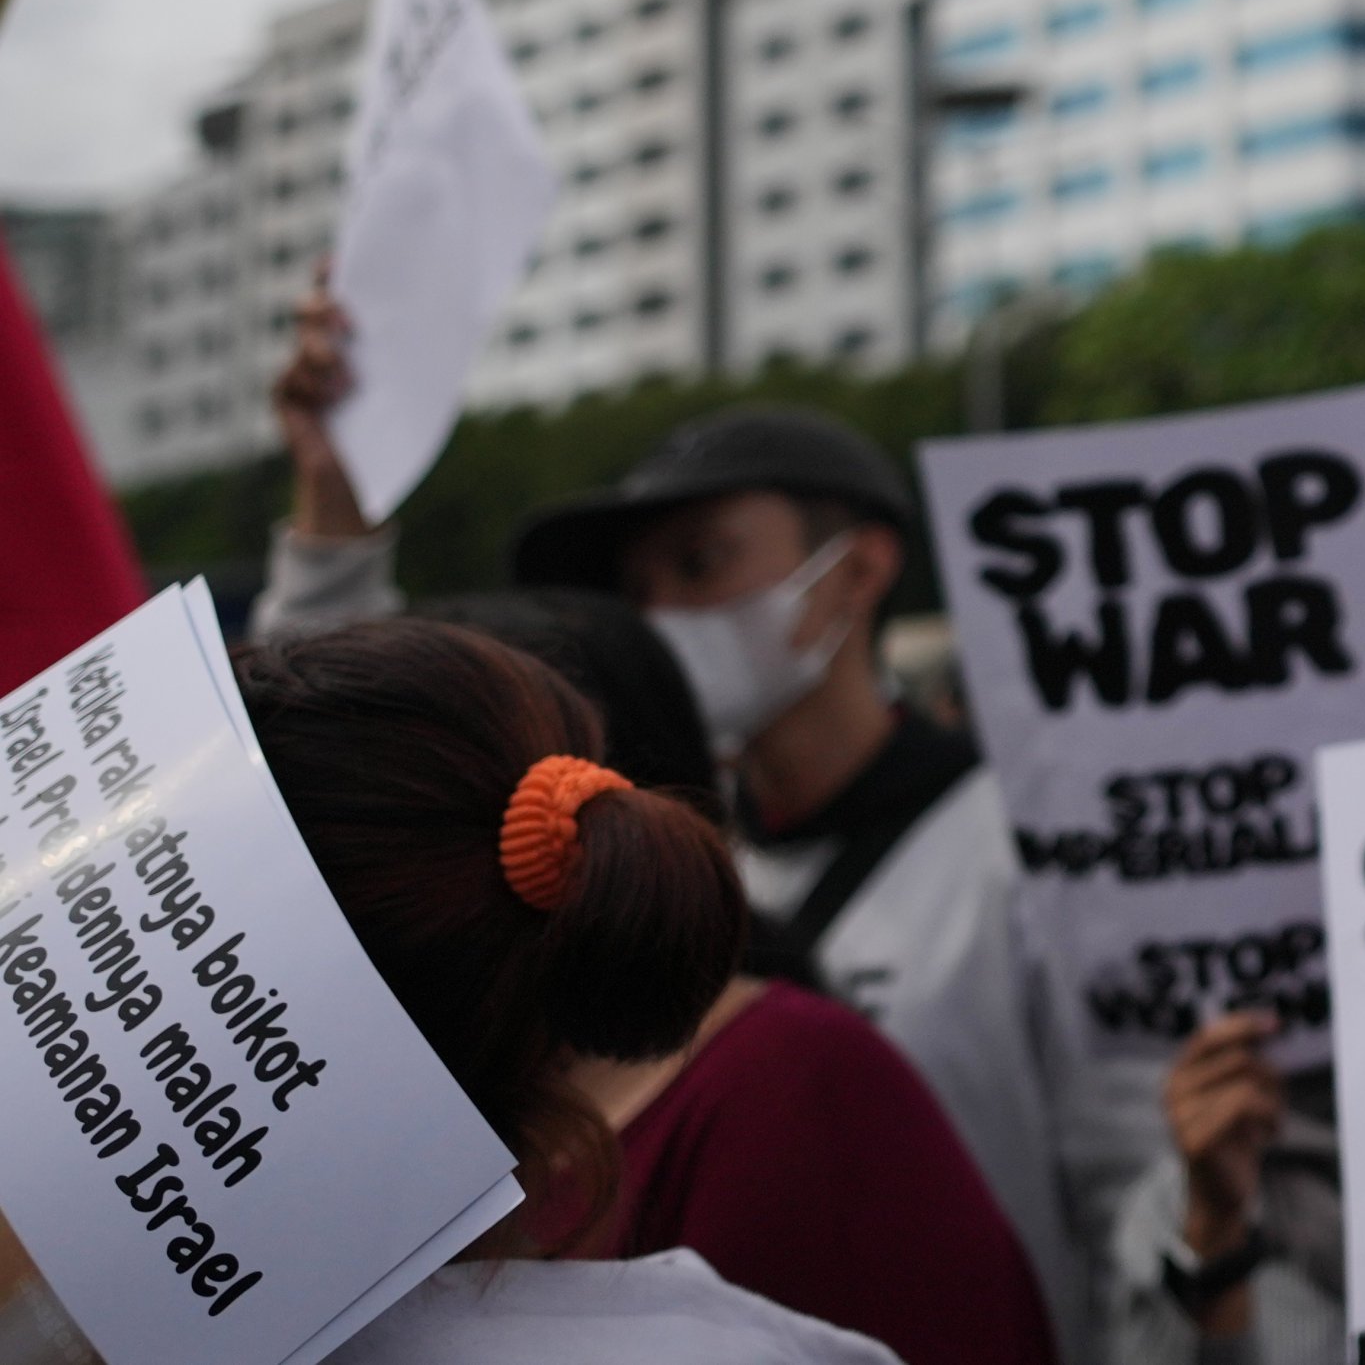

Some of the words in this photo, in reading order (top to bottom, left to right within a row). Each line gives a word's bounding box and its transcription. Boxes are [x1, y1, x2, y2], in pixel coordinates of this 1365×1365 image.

[969, 449, 1363, 598] STOP
[1015, 575, 1355, 713] WAR
[1104, 748, 1298, 831] STOP
[21, 774, 163, 1032] Preidennya
[140, 1022, 269, 1188] malah
[90, 737, 215, 951] rakatnya
[192, 932, 326, 1112] boikot
[0, 913, 141, 1159] keamanan
[115, 1143, 263, 1317] Israel
